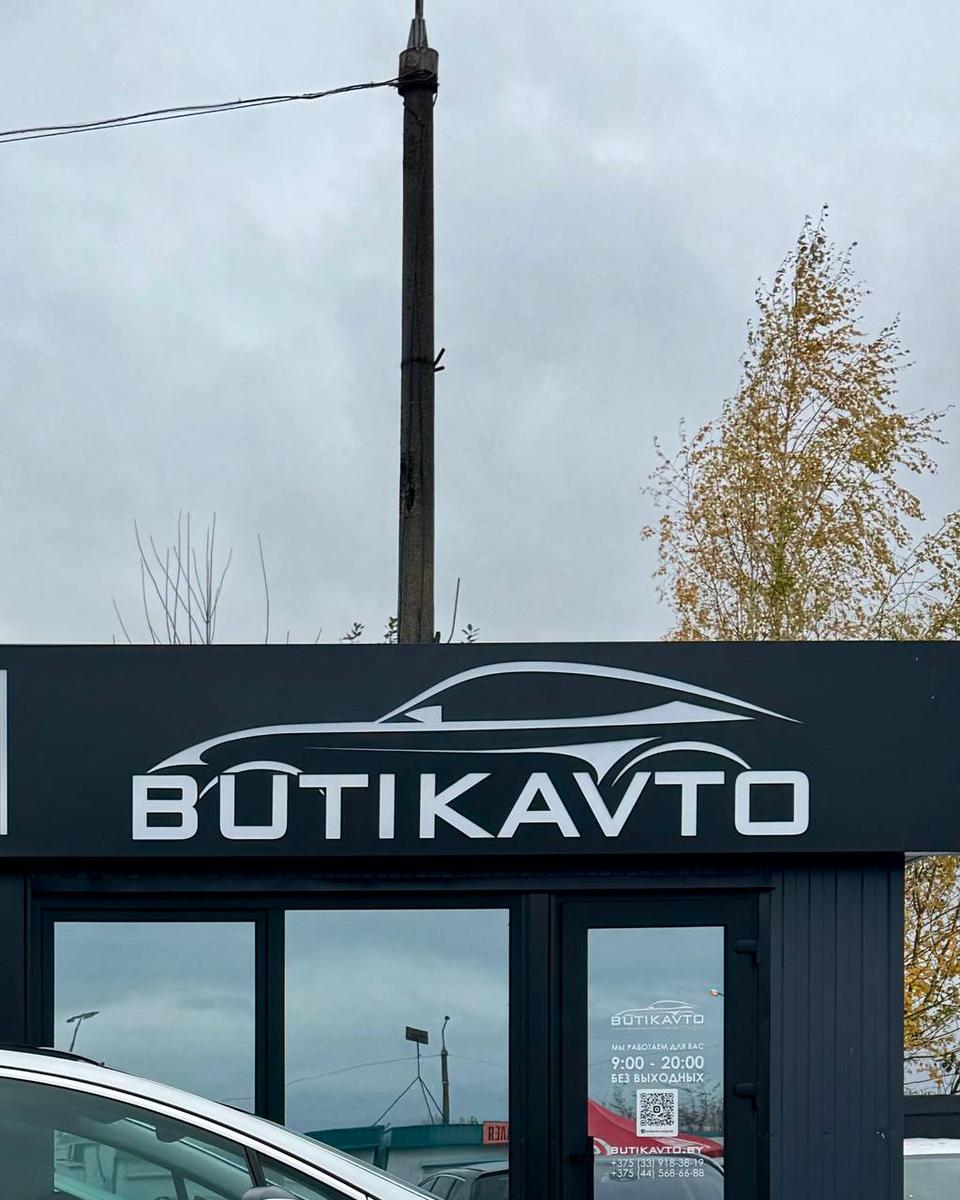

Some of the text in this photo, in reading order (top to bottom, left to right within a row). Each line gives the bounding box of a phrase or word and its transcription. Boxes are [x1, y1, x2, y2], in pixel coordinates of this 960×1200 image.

[131, 768, 810, 841] BUTIKAVTO
[611, 1014, 704, 1025] BUTIKAVTO
[627, 1043, 668, 1051] РАБОТАЕМ
[611, 1056, 644, 1070] 9:00
[661, 1056, 705, 1070] 20:00
[611, 1072, 704, 1084] БЕЗ ВЫХОДНЫХ
[610, 1146, 704, 1155] BUTIKAVTO.BY
[610, 1158, 704, 1169] +375 (33) 918-38-19
[610, 1168, 705, 1179] +375 (44) 568-66-88
